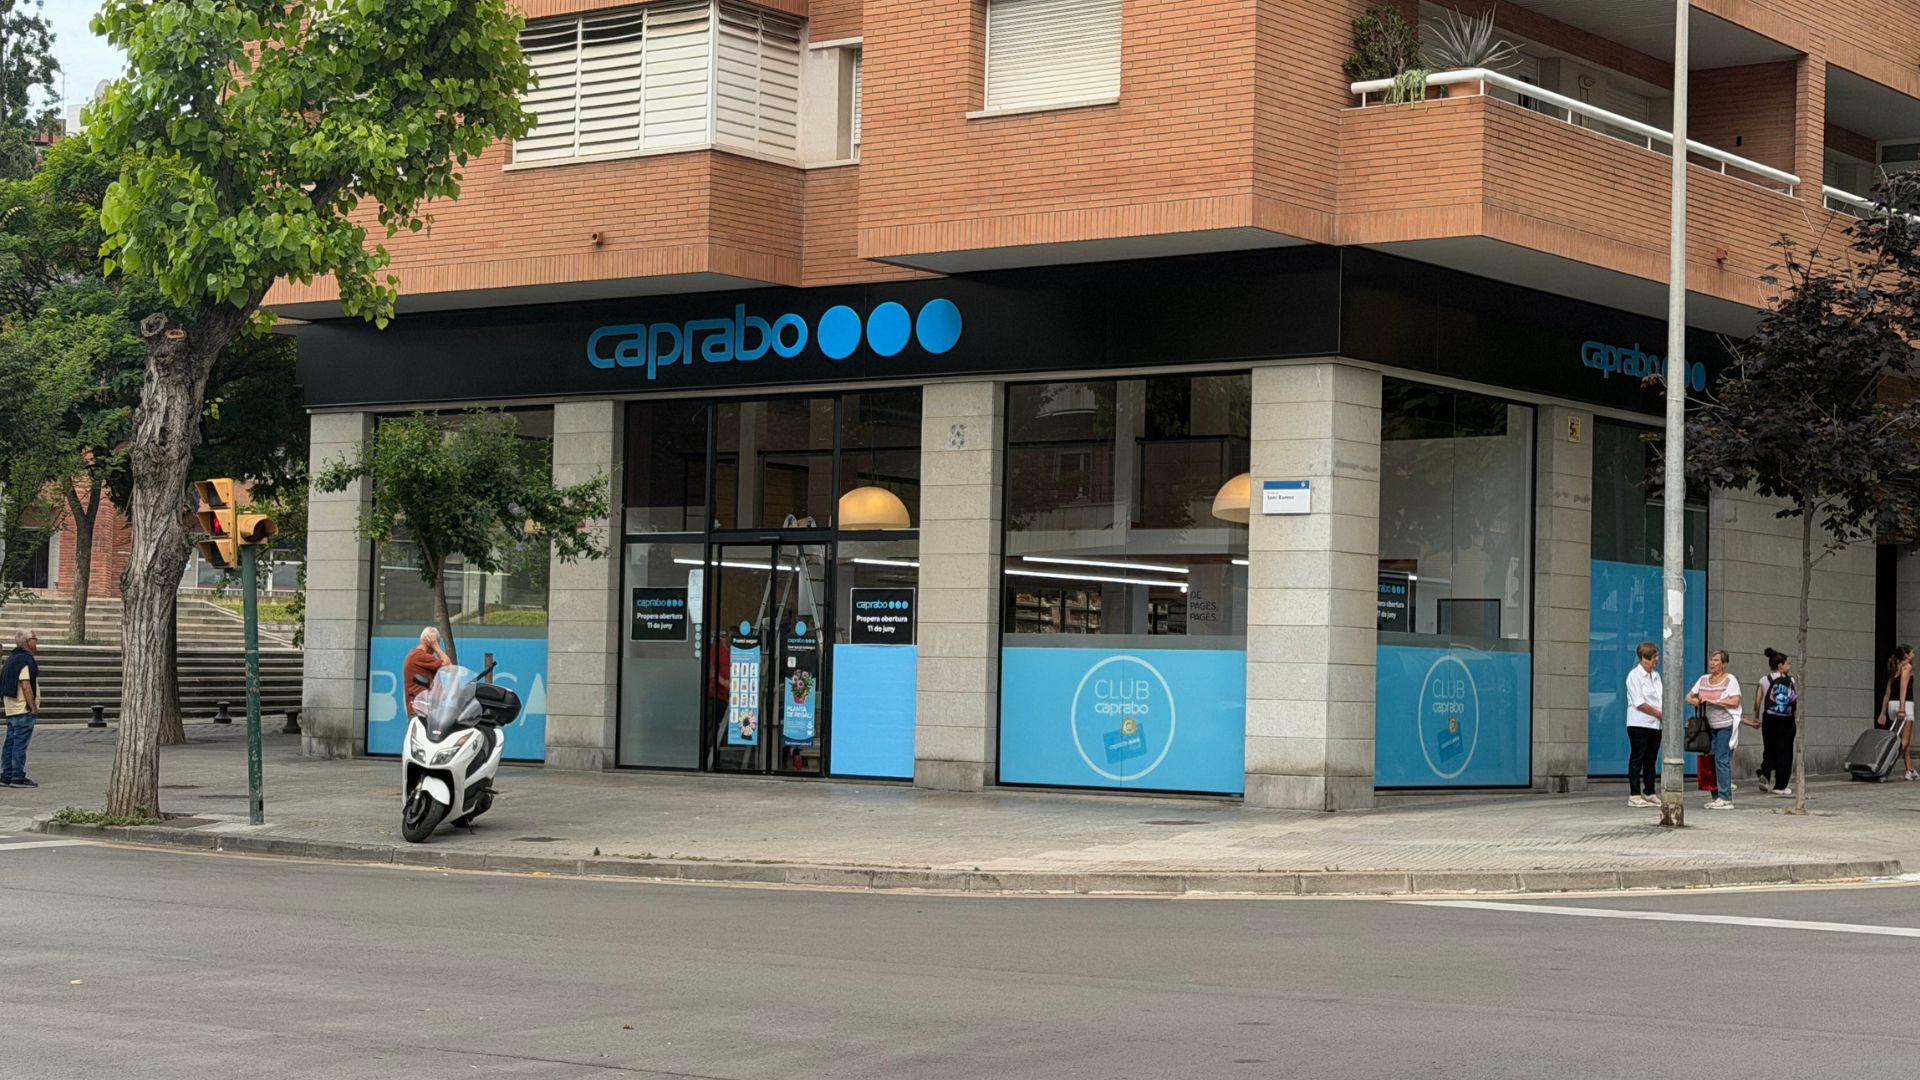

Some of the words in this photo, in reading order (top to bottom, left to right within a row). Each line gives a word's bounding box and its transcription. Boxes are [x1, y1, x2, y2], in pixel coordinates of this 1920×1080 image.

[586, 304, 808, 379] caprabo
[1581, 341, 1660, 379] caprabo
[637, 598, 667, 608] caprabo
[856, 600, 888, 610] caprabo
[636, 612, 659, 620] Propera
[856, 614, 880, 623] Propera
[881, 615, 908, 623] obertura
[882, 625, 896, 634] juny
[1094, 678, 1150, 700] CLUB
[1432, 679, 1465, 699] CLUB
[1094, 700, 1149, 717] caprabo
[1432, 700, 1465, 715] caprabo
